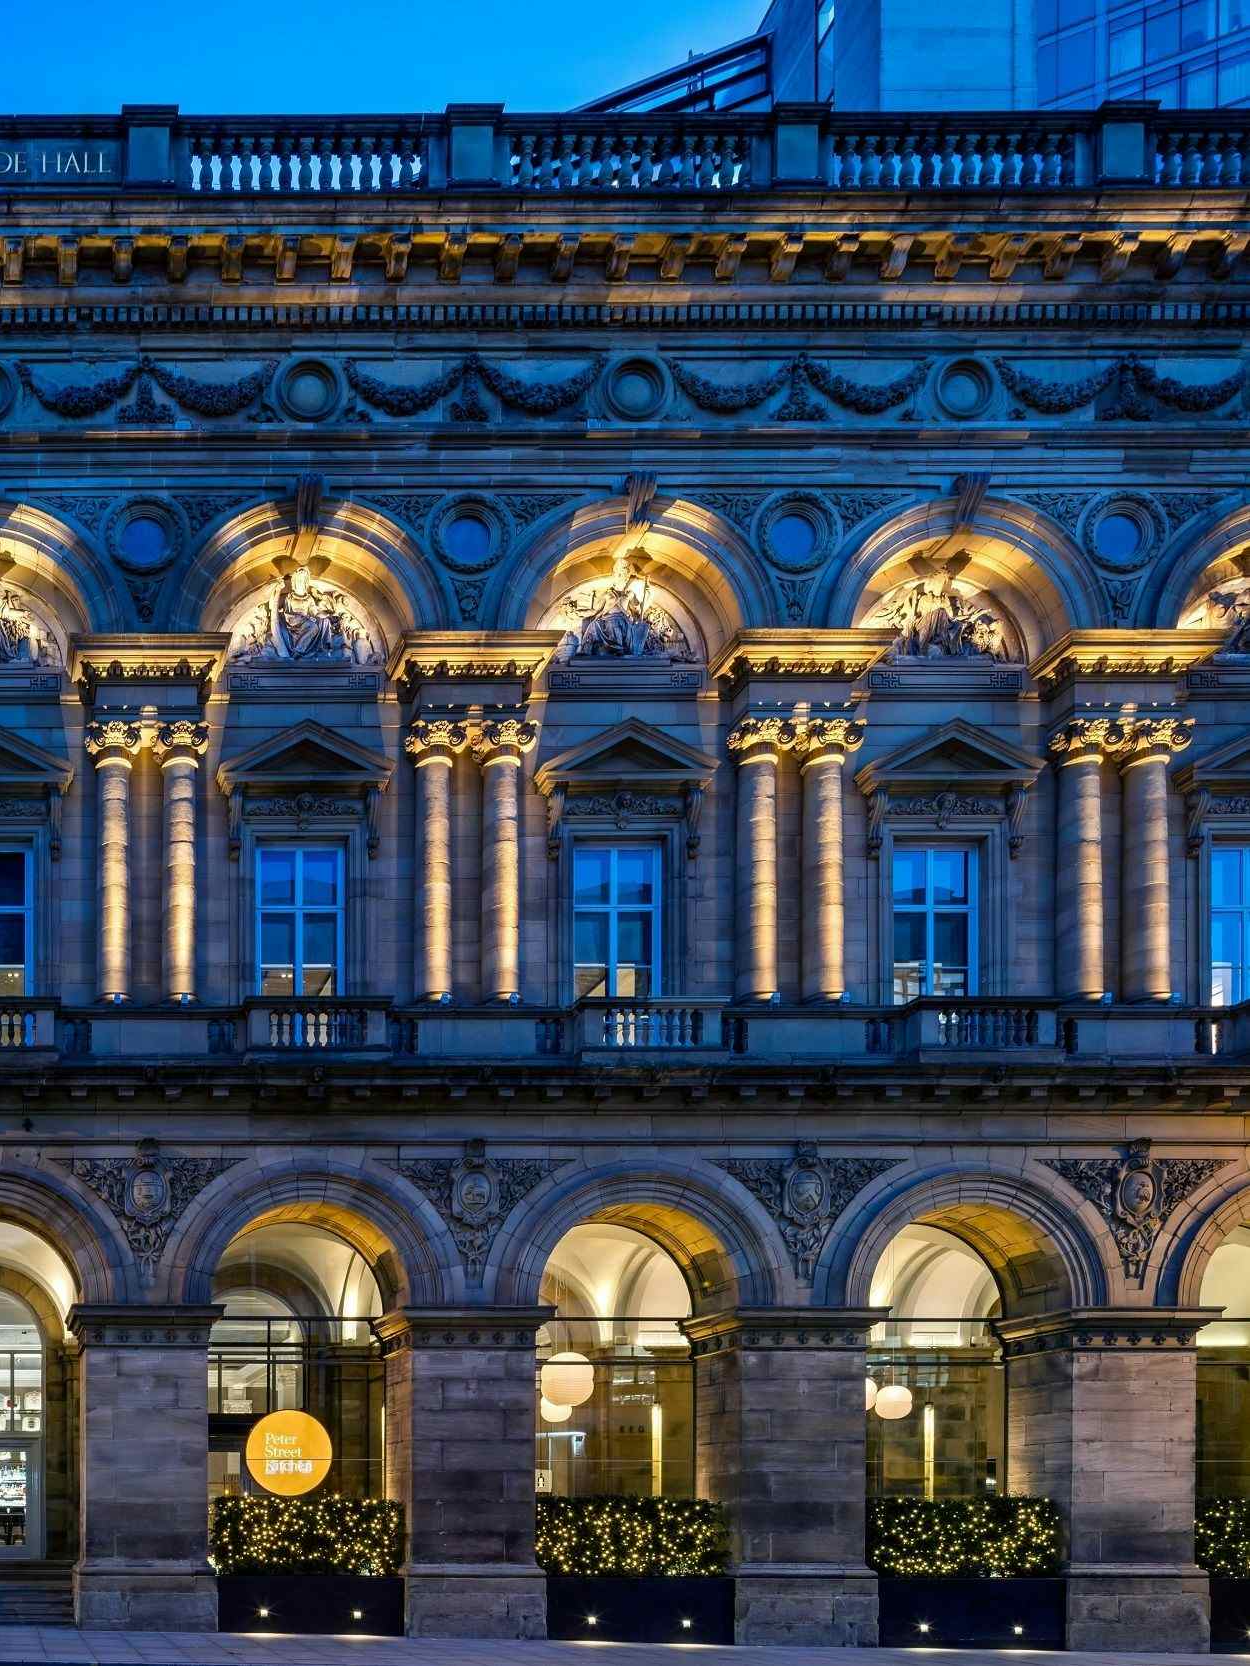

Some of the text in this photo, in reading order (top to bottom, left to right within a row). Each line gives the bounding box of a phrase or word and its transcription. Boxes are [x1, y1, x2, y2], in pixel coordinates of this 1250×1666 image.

[38, 151, 113, 174] HALL
[265, 1432, 298, 1445] Peter
[265, 1446, 303, 1458] Street
[265, 1458, 313, 1474] Kitchen
